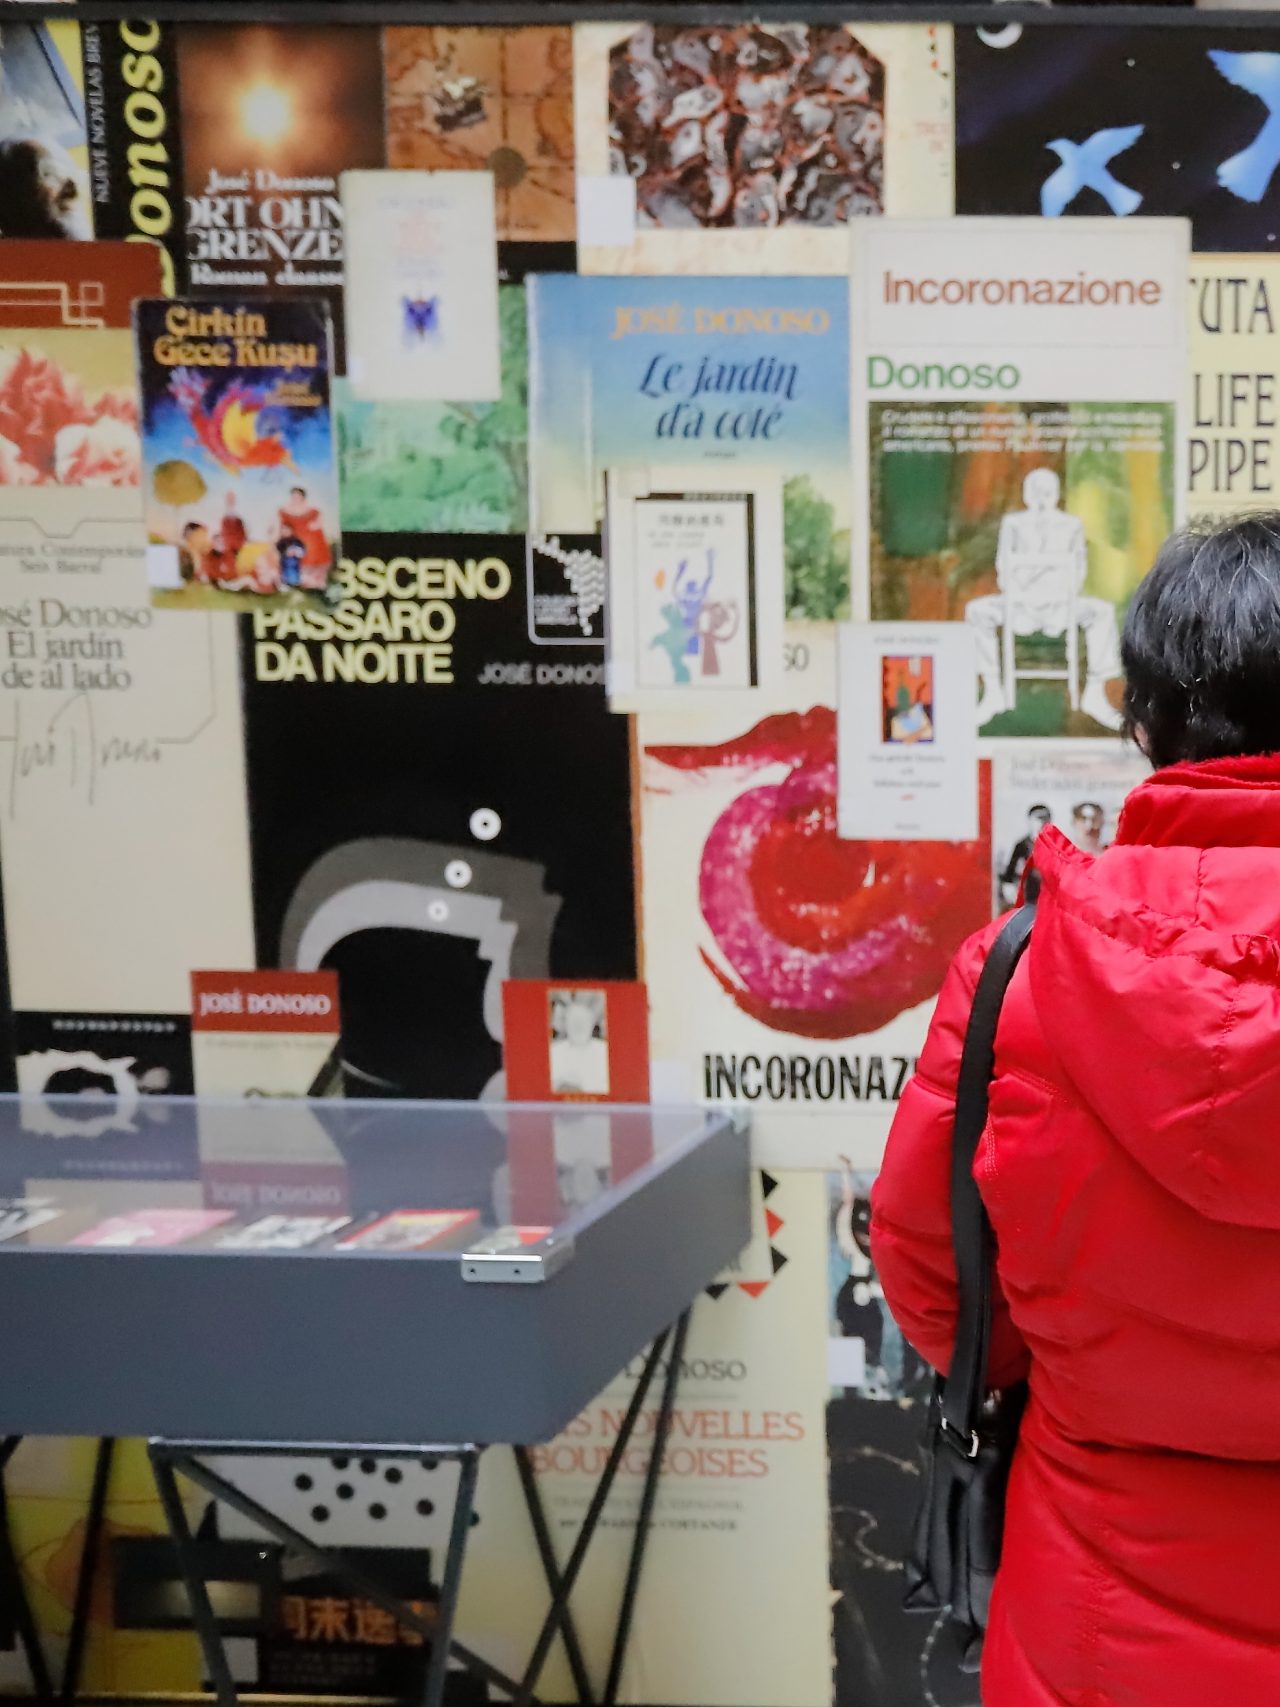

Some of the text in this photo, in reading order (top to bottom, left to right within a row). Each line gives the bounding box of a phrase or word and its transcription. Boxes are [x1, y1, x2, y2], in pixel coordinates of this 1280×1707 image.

[882, 270, 1163, 306] Incoronazione
[1189, 278, 1276, 334] UTA
[609, 301, 830, 341] JOSÉ DONOSO
[153, 335, 231, 367] Gece
[638, 352, 801, 402] Le jardin
[867, 355, 1021, 390] Donoso
[1193, 373, 1275, 428] LIFE
[1188, 438, 1272, 492] PIPE
[40, 598, 152, 629] Donoso
[8, 630, 36, 659] El
[2, 661, 132, 691] de al lado
[254, 641, 454, 685] DA NOITE
[247, 992, 331, 1015] DONOSO
